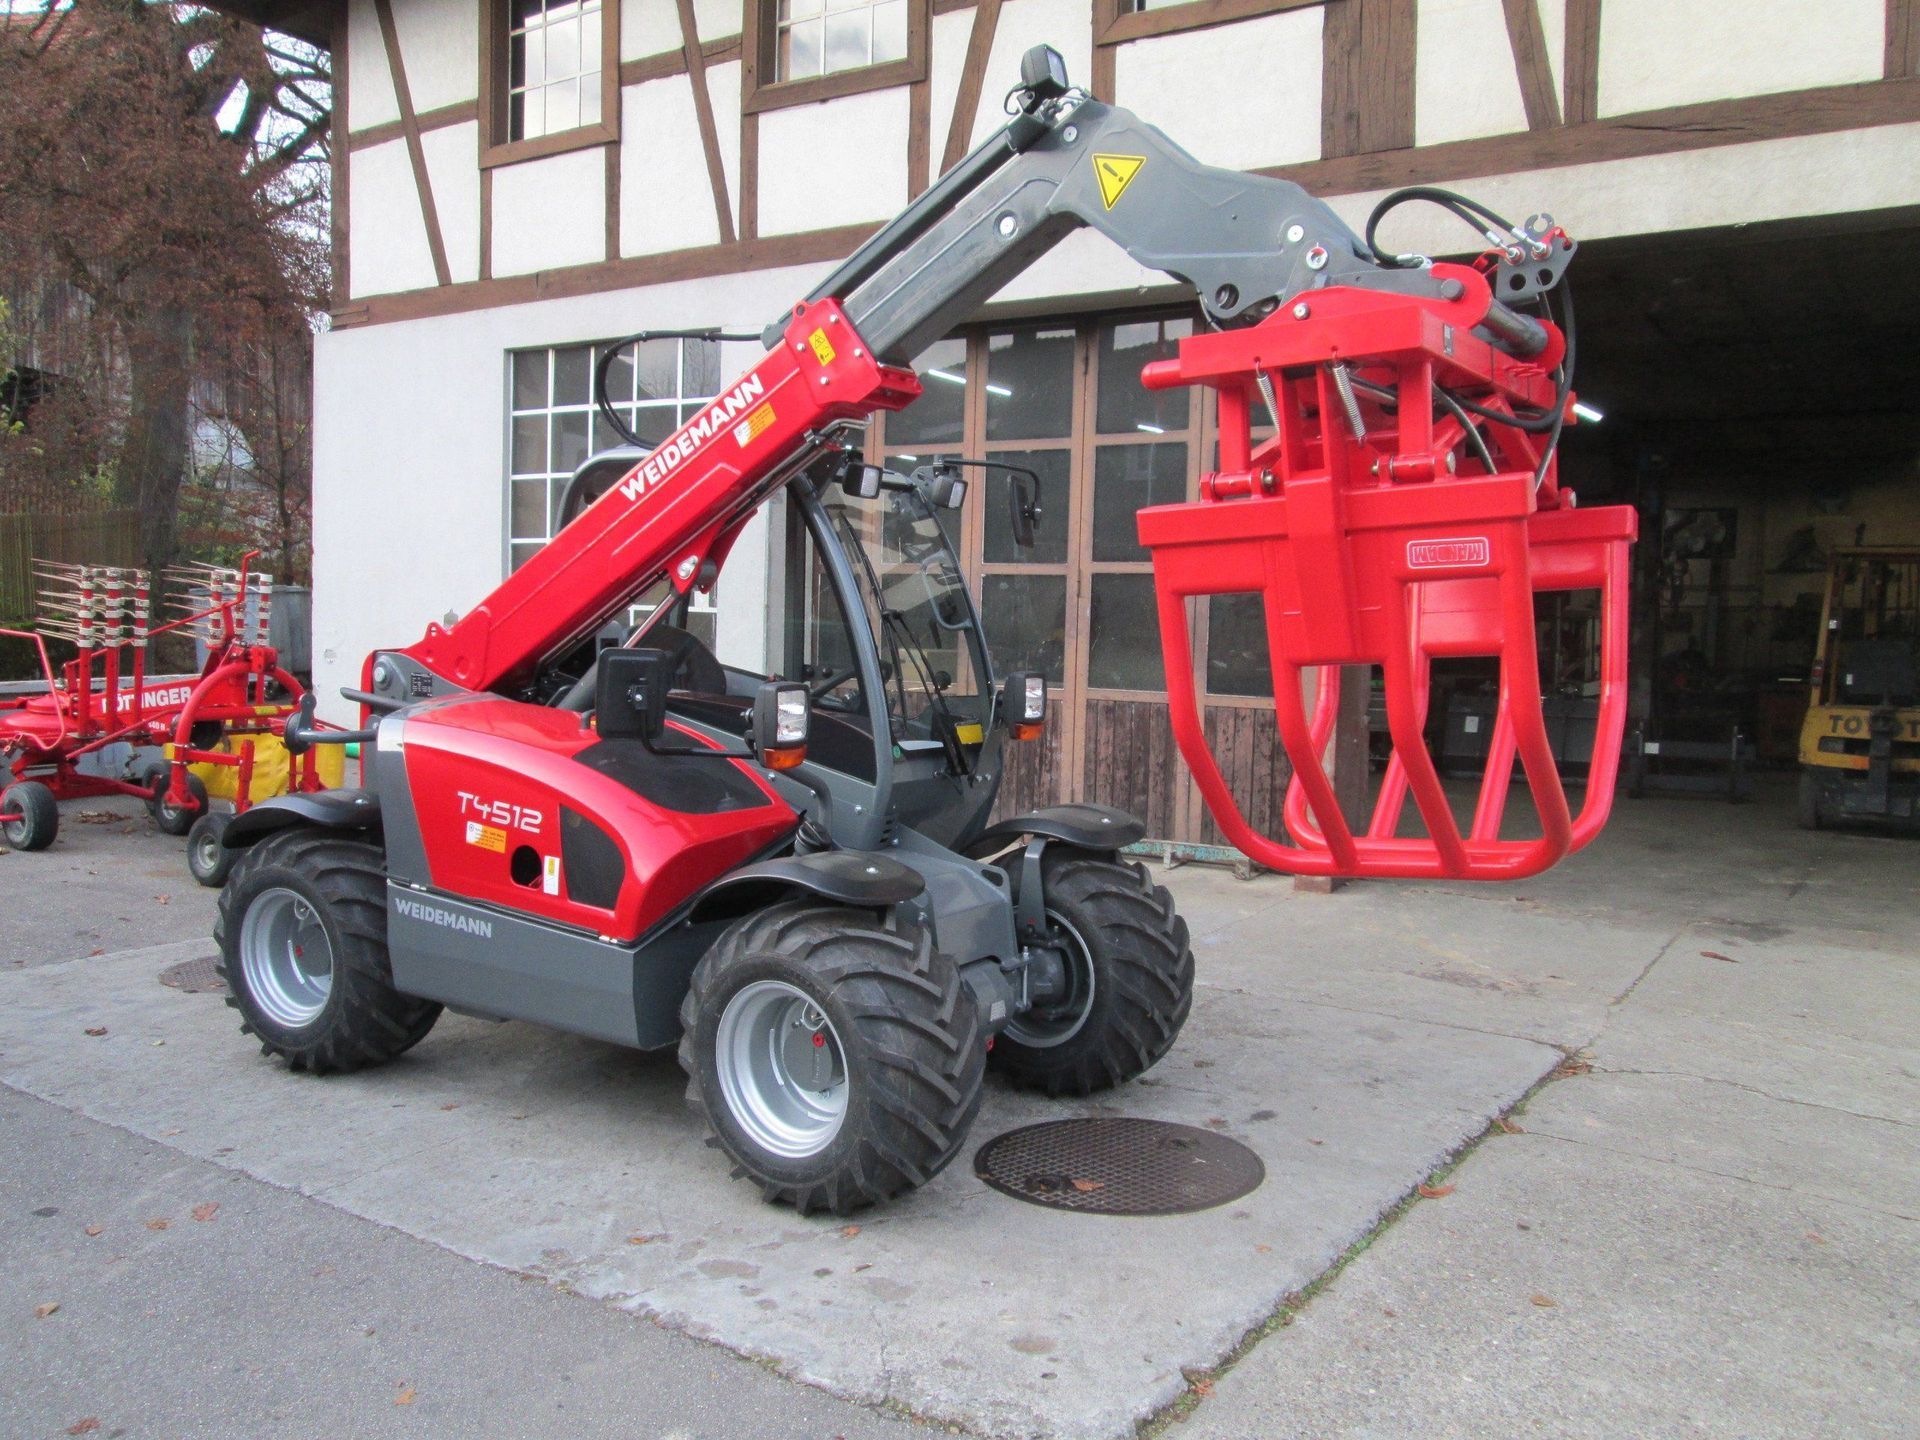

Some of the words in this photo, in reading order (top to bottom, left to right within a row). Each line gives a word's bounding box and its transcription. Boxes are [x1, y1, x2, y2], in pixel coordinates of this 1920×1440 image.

[619, 373, 764, 501] WEIDEMANN
[457, 791, 543, 834] T4512
[395, 898, 492, 938] WEIDEMANN
